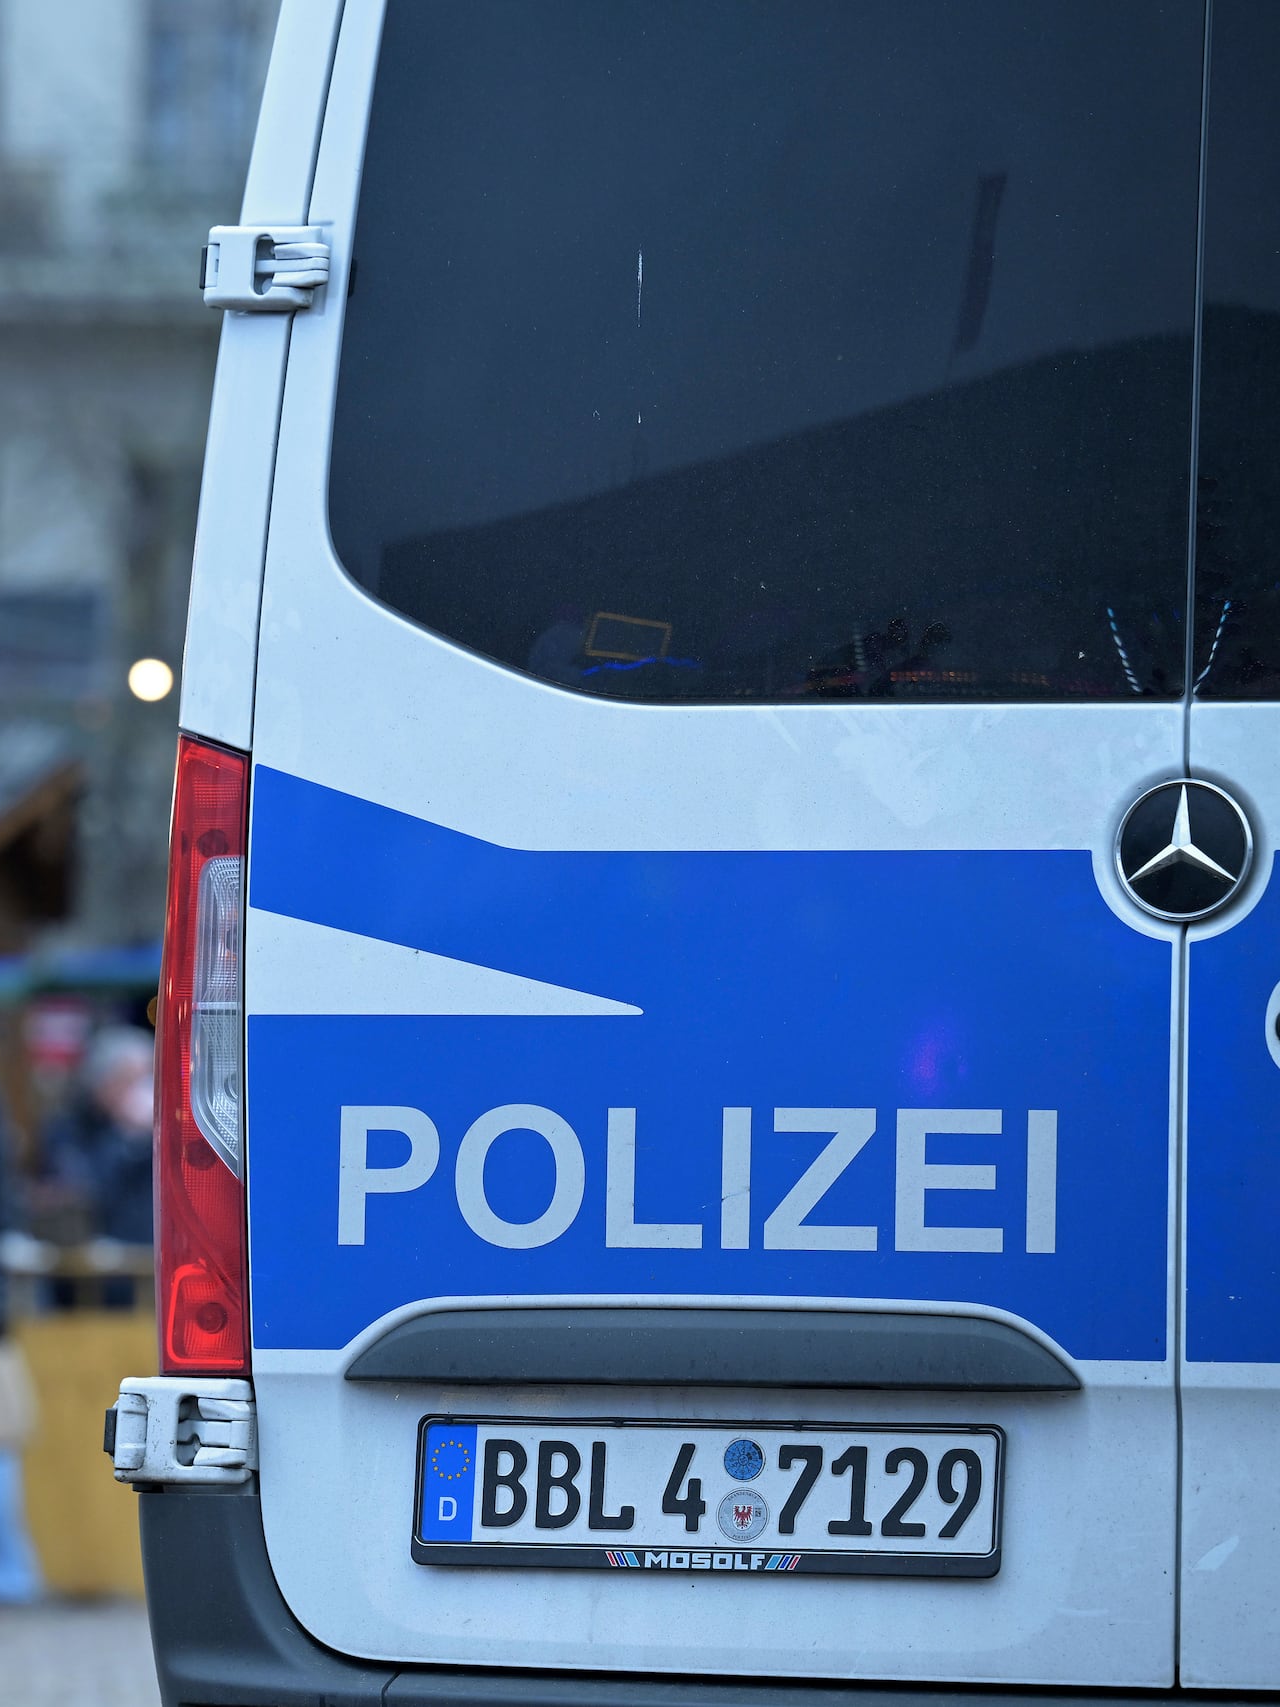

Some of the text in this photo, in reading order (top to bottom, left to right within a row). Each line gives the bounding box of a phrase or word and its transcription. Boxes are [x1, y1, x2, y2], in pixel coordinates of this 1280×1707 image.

[338, 1103, 1058, 1254] POLIZEI
[438, 1496, 458, 1521] D
[481, 1439, 635, 1530] BBL
[662, 1443, 706, 1531] 4
[778, 1445, 982, 1538] 7129
[644, 1551, 766, 1570] MOSOLF
